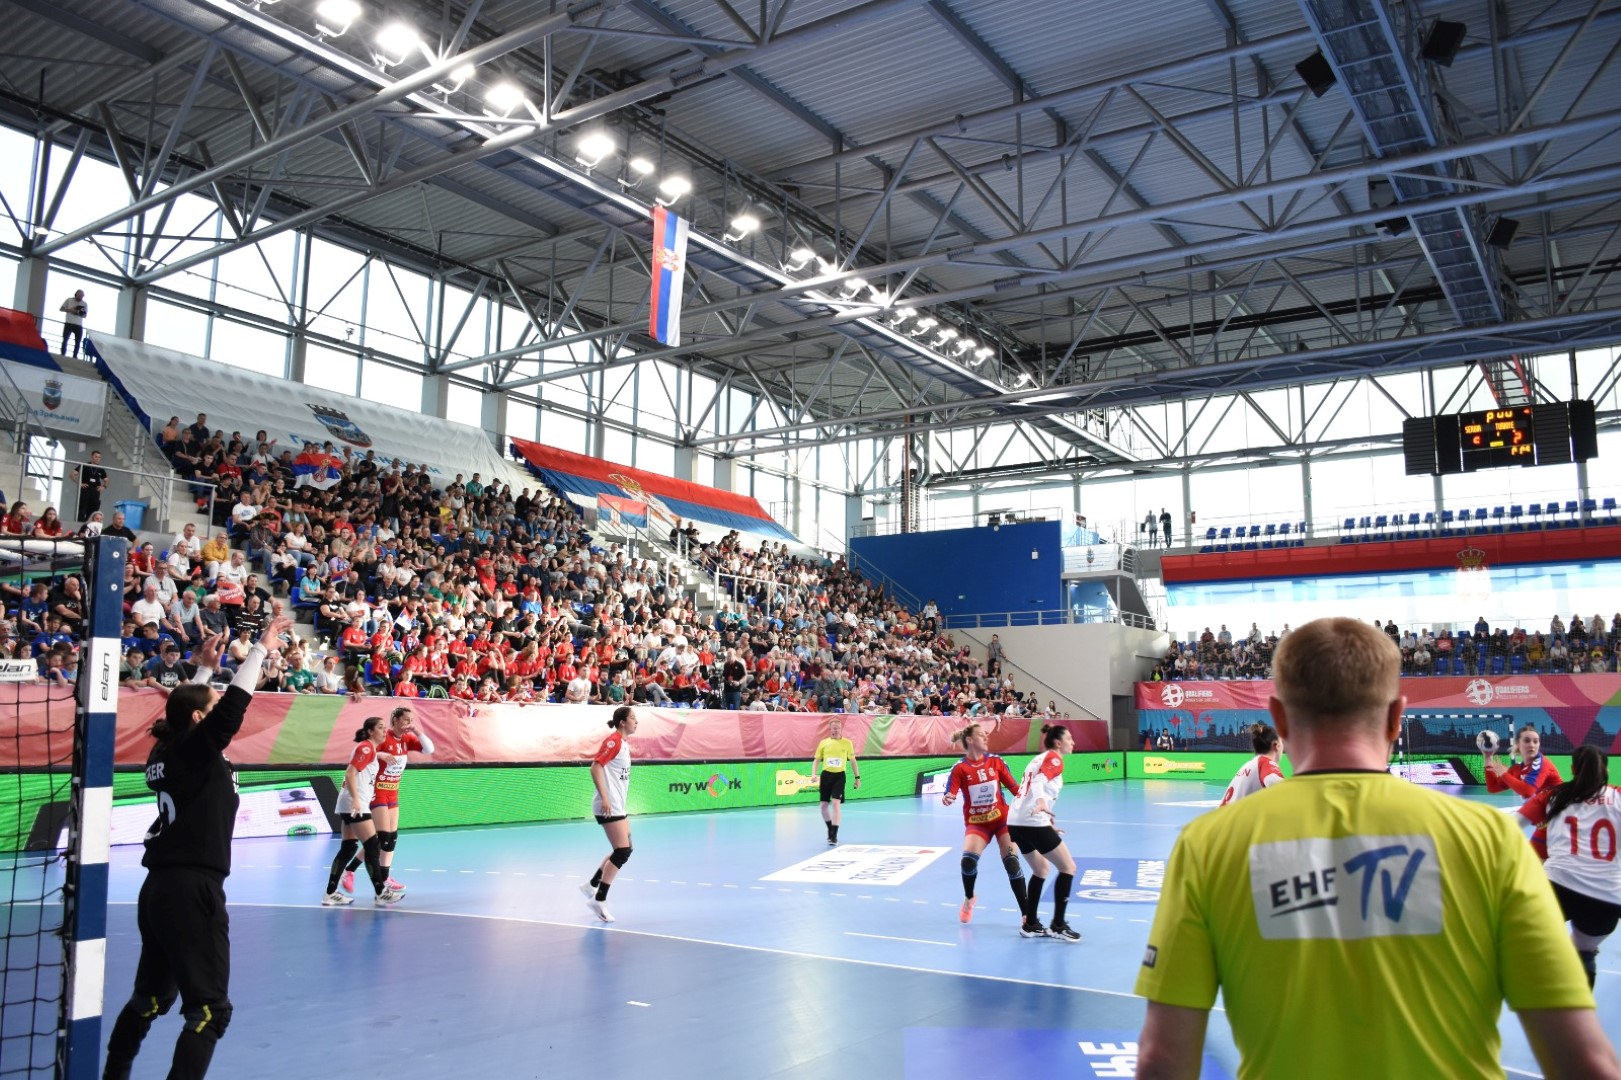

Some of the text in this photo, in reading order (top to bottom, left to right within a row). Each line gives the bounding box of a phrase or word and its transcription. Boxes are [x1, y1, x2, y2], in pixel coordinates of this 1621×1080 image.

[101, 652, 110, 701] elan
[669, 782, 692, 794] my
[1564, 816, 1616, 862] 10
[1269, 845, 1426, 922] EHF TV
